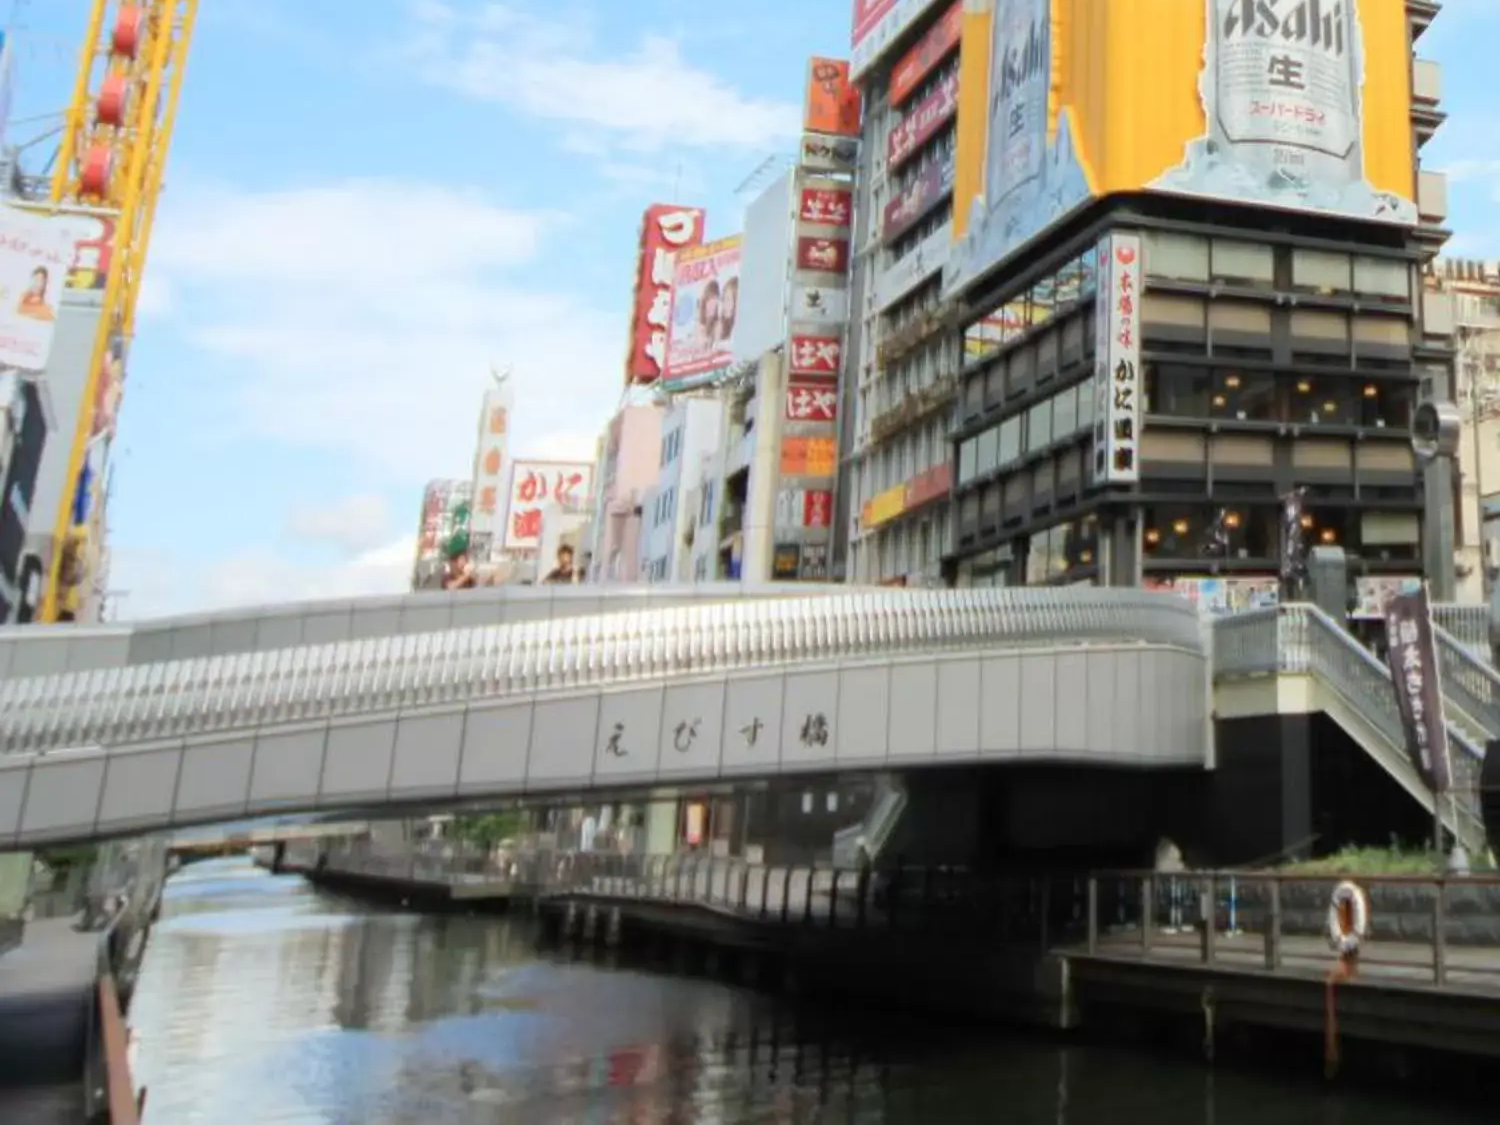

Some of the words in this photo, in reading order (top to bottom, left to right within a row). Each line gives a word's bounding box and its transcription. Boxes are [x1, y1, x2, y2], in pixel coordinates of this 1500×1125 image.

[1267, 54, 1306, 91] 生
[1248, 100, 1327, 125] スーパードライ
[605, 710, 830, 759] えびす橋
